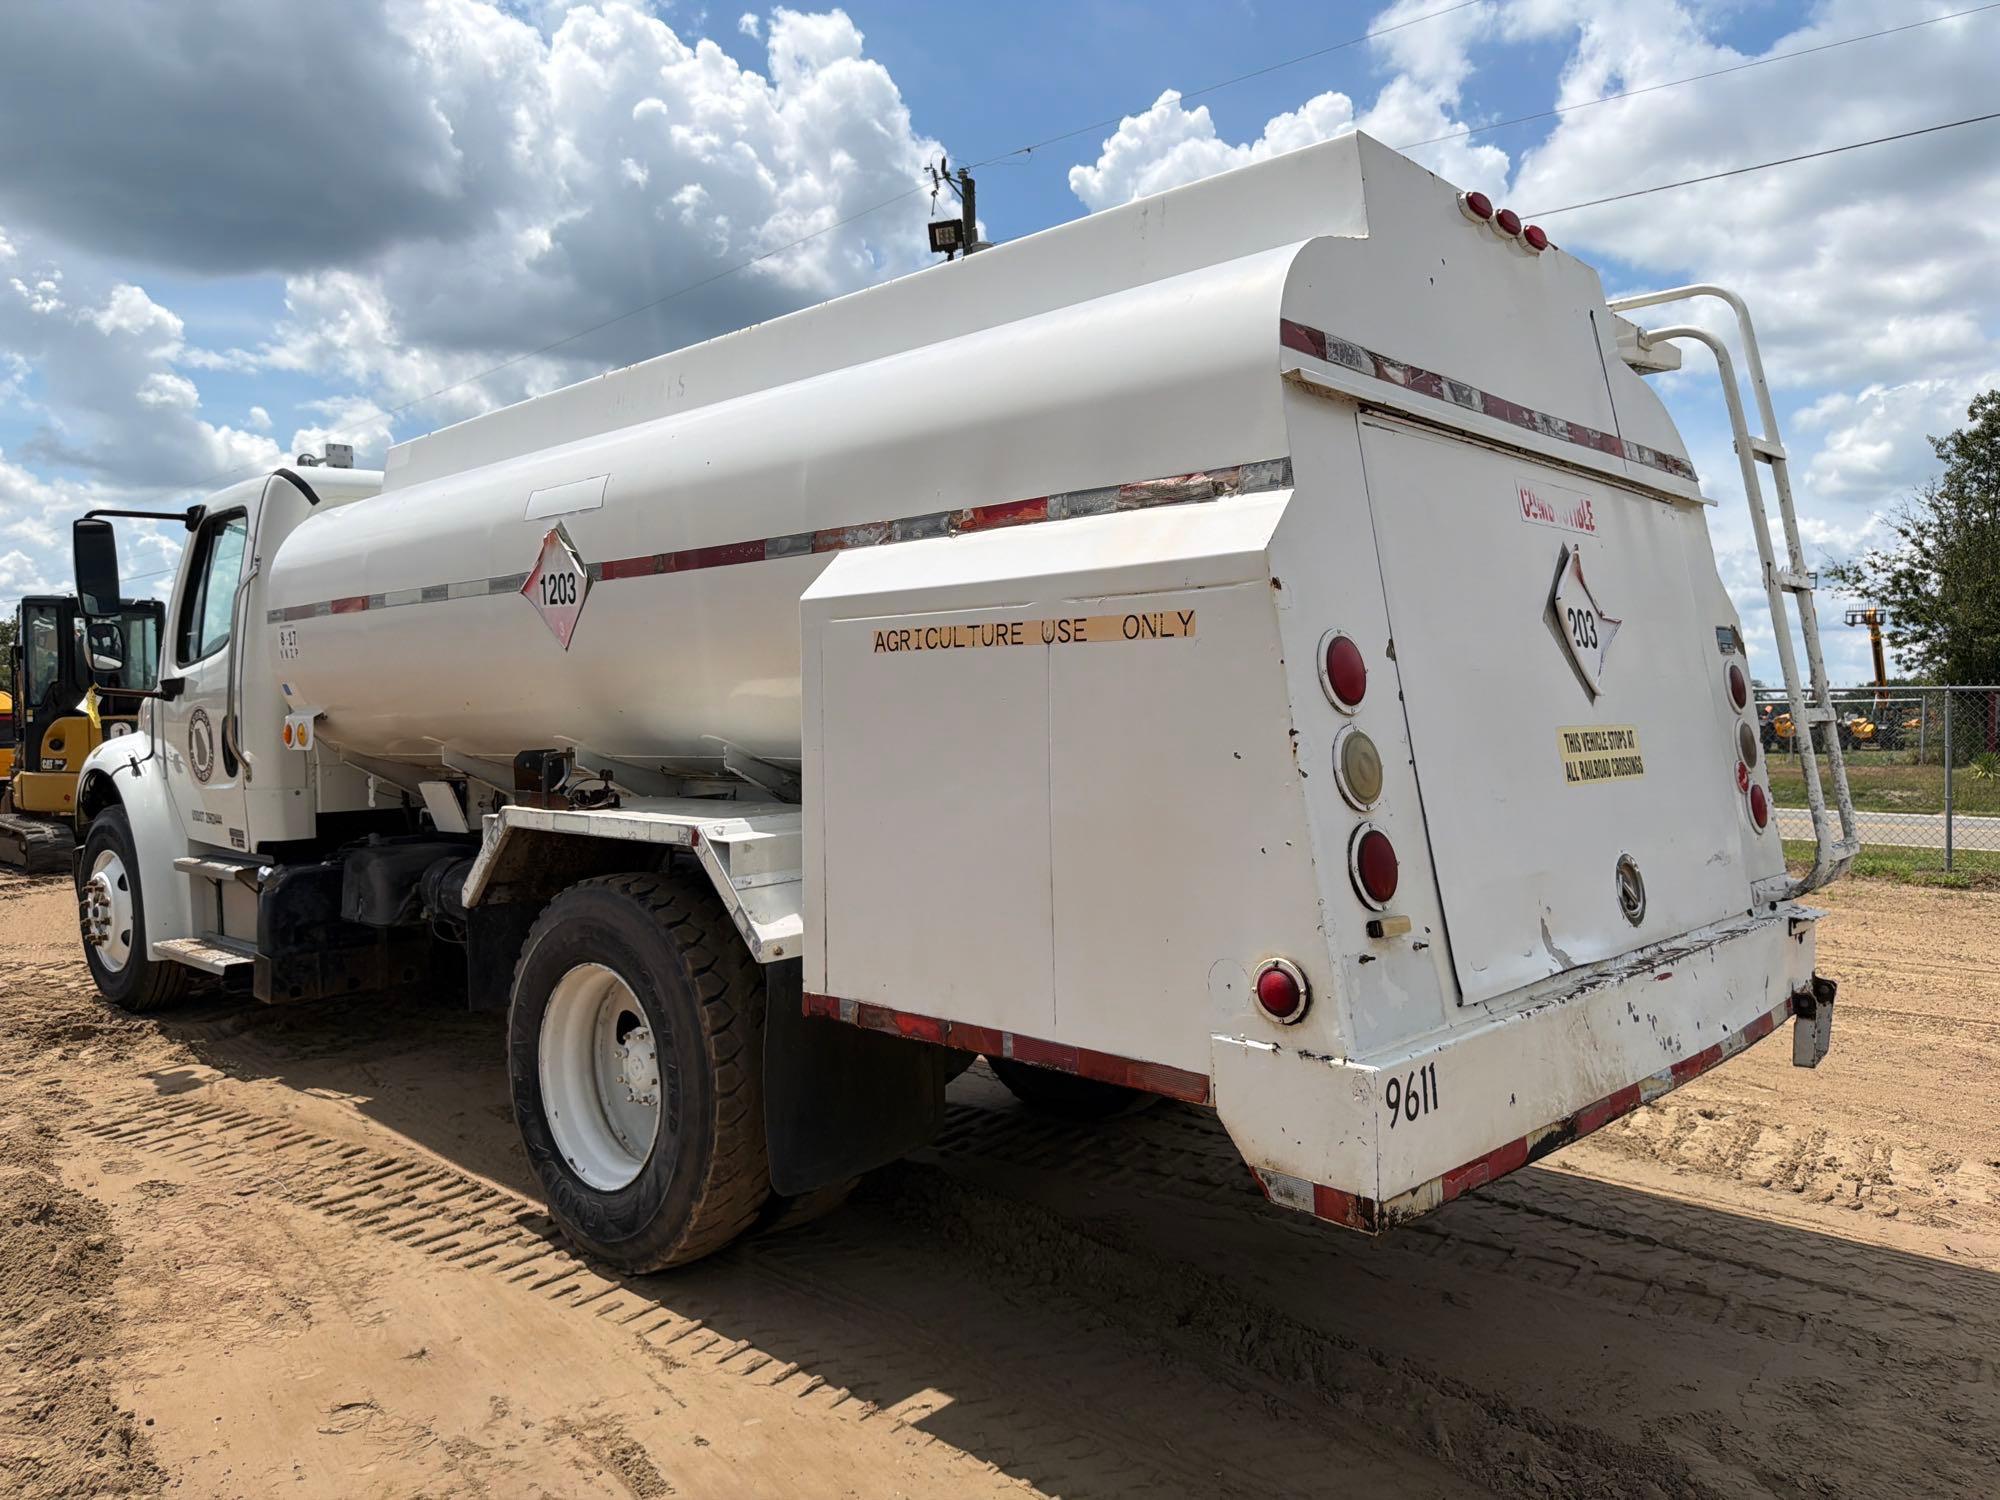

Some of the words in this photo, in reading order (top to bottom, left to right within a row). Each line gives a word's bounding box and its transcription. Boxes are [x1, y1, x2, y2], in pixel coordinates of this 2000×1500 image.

[540, 572, 576, 606] 1203
[873, 622, 1024, 653] AGRICULTURE
[1041, 617, 1088, 645] USE
[1122, 609, 1195, 641] ONLY
[1563, 733, 1581, 753] THIS
[1581, 732, 1608, 751] VEHICLE
[1607, 730, 1627, 750] STOPS
[1627, 730, 1635, 749] AT
[42, 759, 53, 769] CAT
[1565, 760, 1580, 782] ALL
[1579, 758, 1611, 780] RAILROAD
[1611, 755, 1643, 776] CROSSINGS
[1385, 1061, 1439, 1130] 9611
